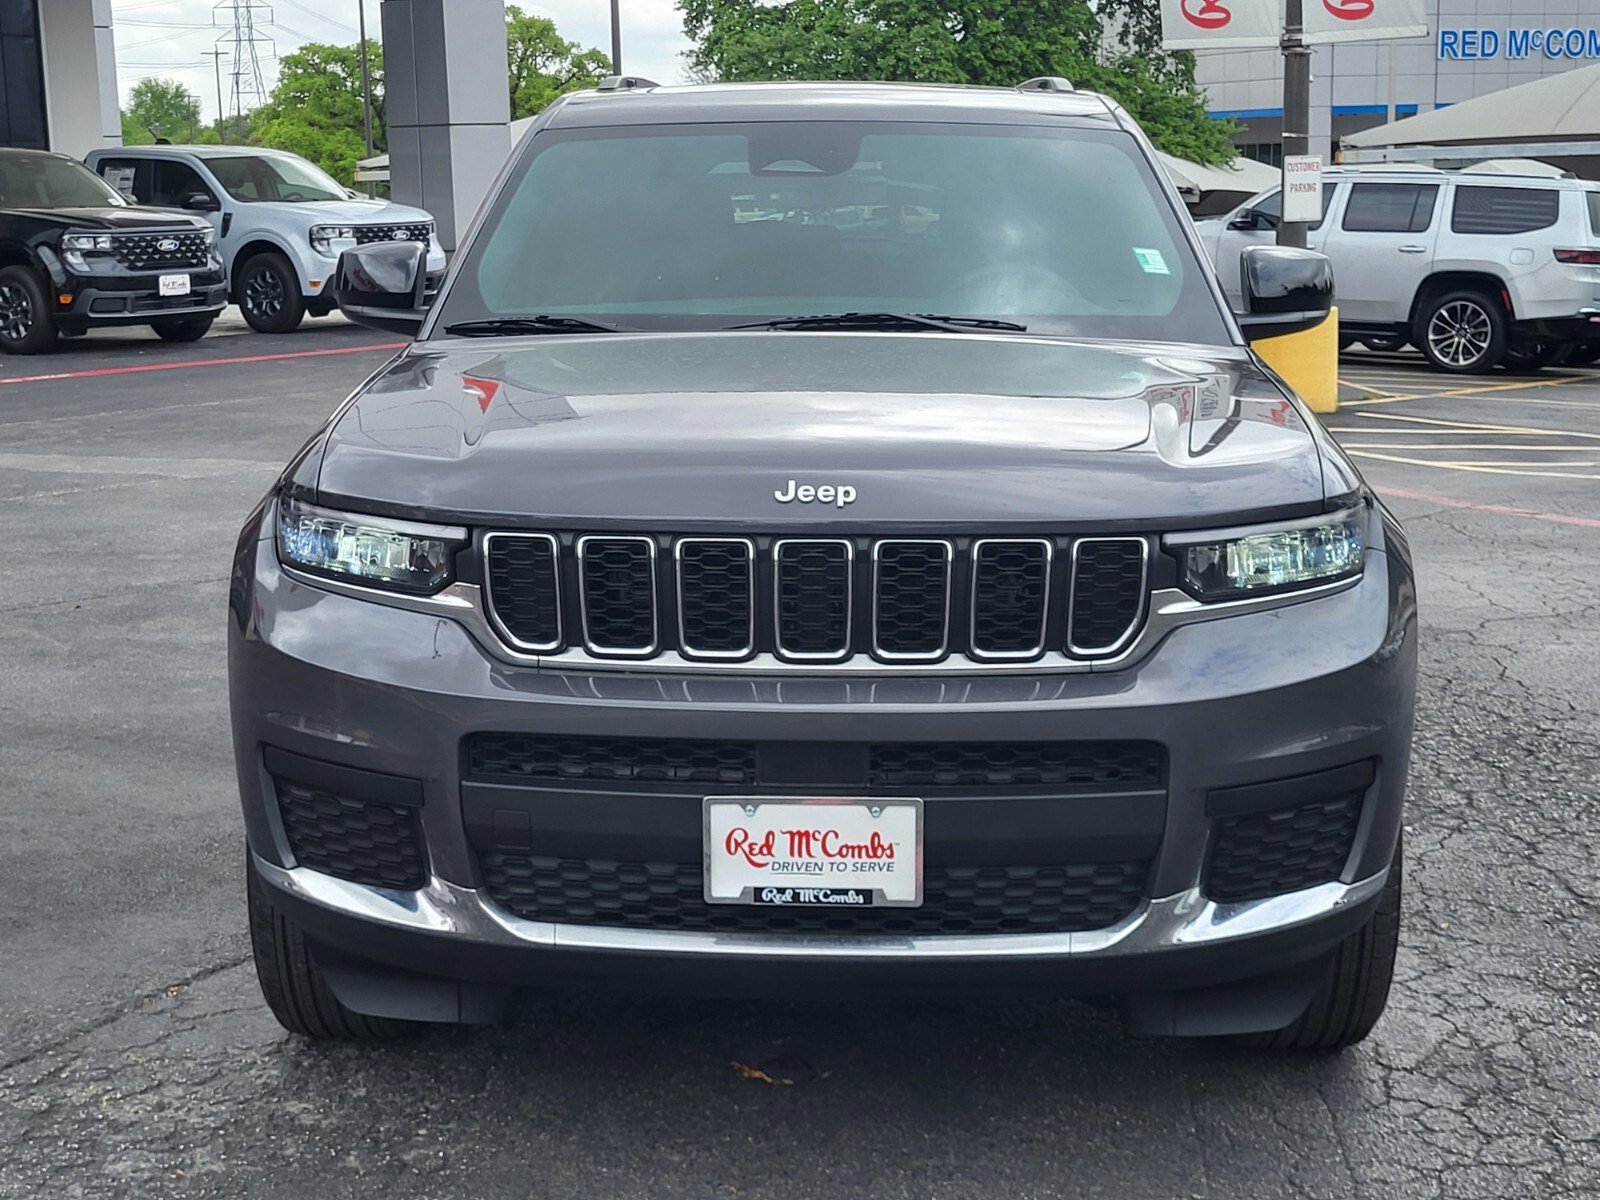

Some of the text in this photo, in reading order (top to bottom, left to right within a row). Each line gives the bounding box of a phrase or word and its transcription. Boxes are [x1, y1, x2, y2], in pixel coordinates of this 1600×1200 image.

[1439, 30, 1499, 59] RED
[1287, 162, 1320, 172] CUSTOMER
[1290, 183, 1317, 192] PARKING
[774, 480, 857, 508] Jeep
[725, 827, 895, 868] Red McCombs
[771, 861, 895, 873] DRIVEN TO SERVE
[761, 887, 865, 904] Red McCombs
